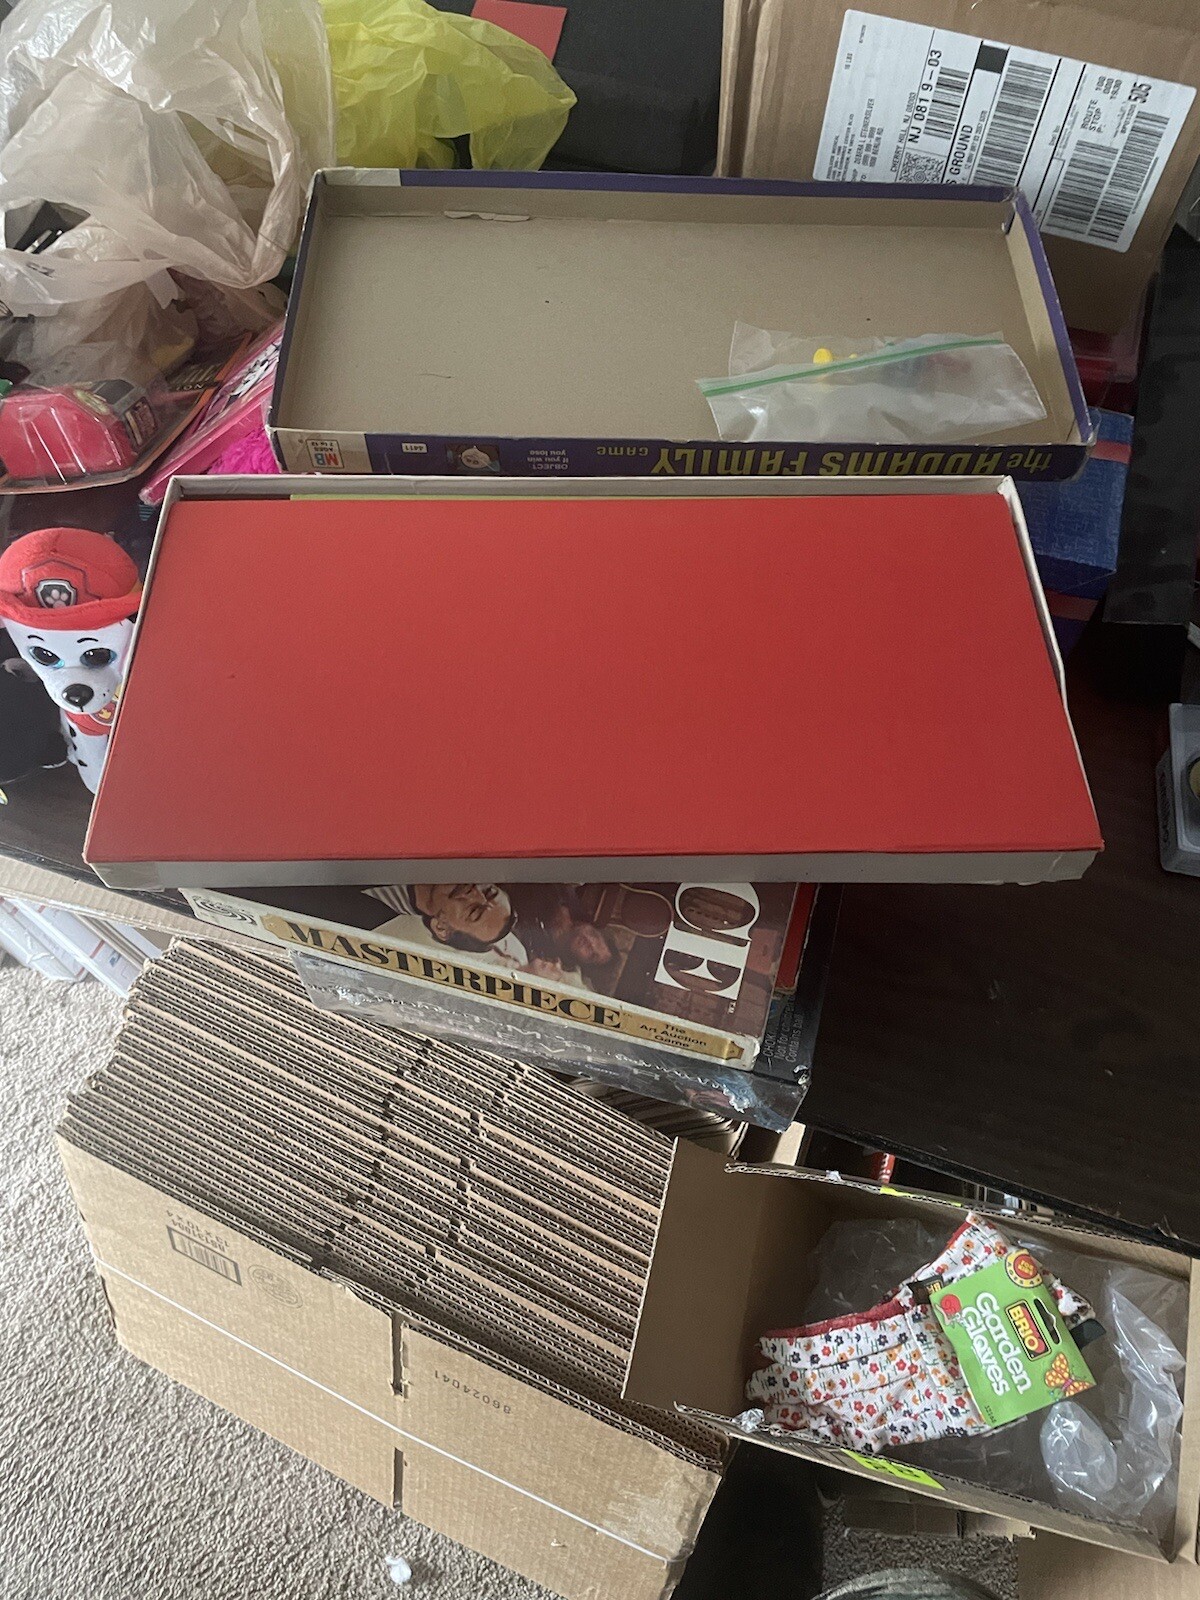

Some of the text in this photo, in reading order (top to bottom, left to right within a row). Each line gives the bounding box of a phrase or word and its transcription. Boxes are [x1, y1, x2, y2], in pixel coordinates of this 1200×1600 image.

[907, 126, 922, 143] NJ
[916, 97, 930, 121] 081
[1081, 99, 1097, 129] ROUTE
[1088, 108, 1102, 132] STOP
[949, 125, 973, 175] GROUND
[314, 451, 339, 466] MB
[650, 448, 808, 476] FAMILY
[1006, 448, 1053, 474] the
[654, 881, 760, 1000] CE
[283, 919, 623, 1030] MASTERPIECE
[654, 1034, 690, 1048] Game
[661, 1029, 707, 1047] Auction
[664, 1023, 686, 1034] The
[975, 1291, 1032, 1395] Garden
[1010, 1305, 1039, 1351] BRIO
[961, 1306, 1010, 1397] Gloves
